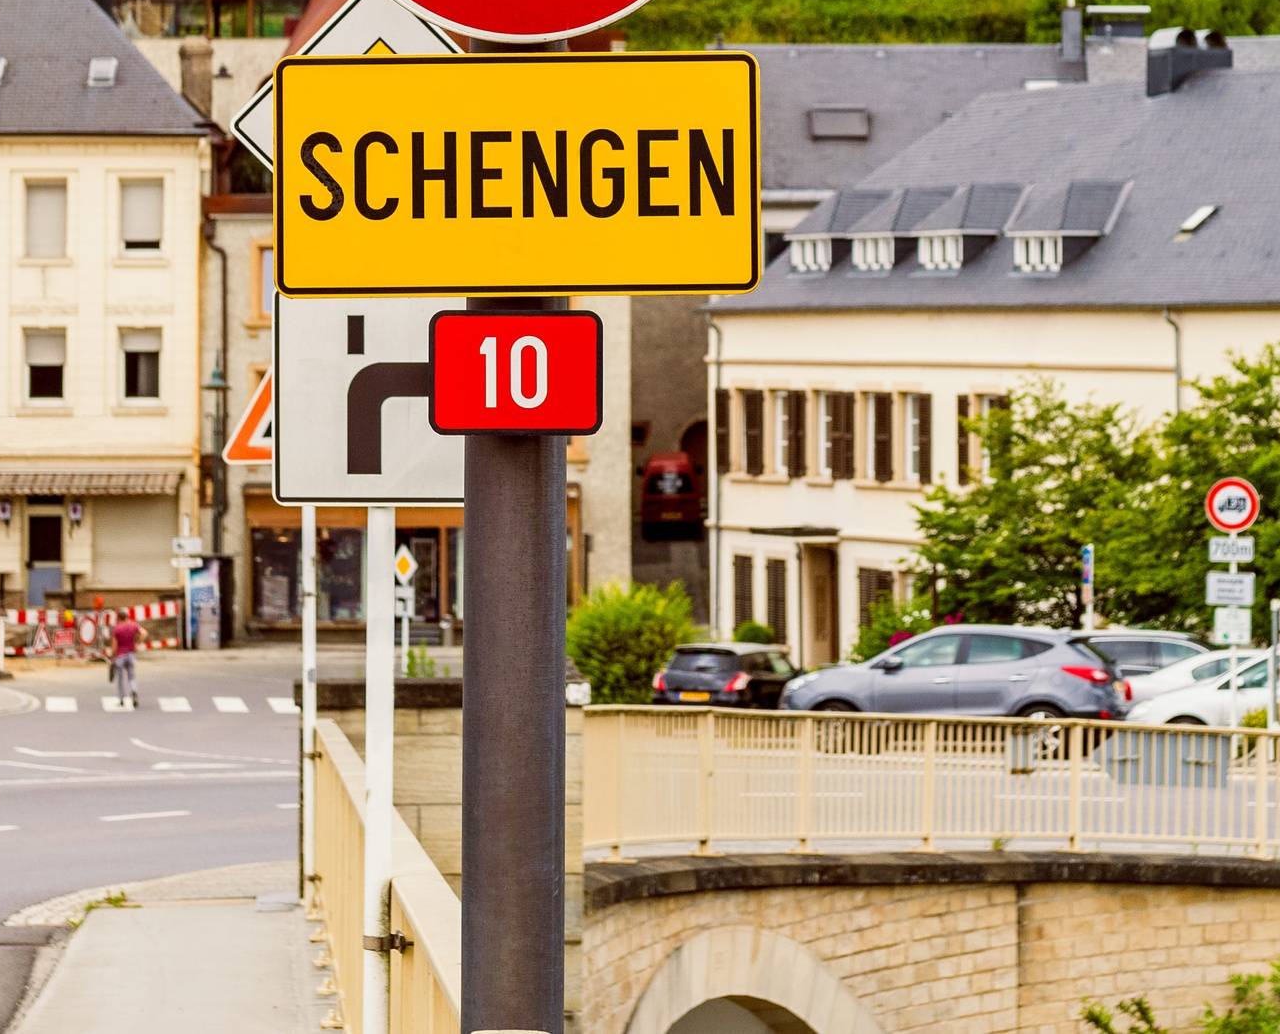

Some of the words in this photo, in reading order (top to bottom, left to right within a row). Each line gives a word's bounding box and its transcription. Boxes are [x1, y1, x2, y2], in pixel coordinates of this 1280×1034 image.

[300, 129, 735, 221] SCHENGEN
[480, 336, 548, 408] 10
[1213, 540, 1252, 556] 700m
